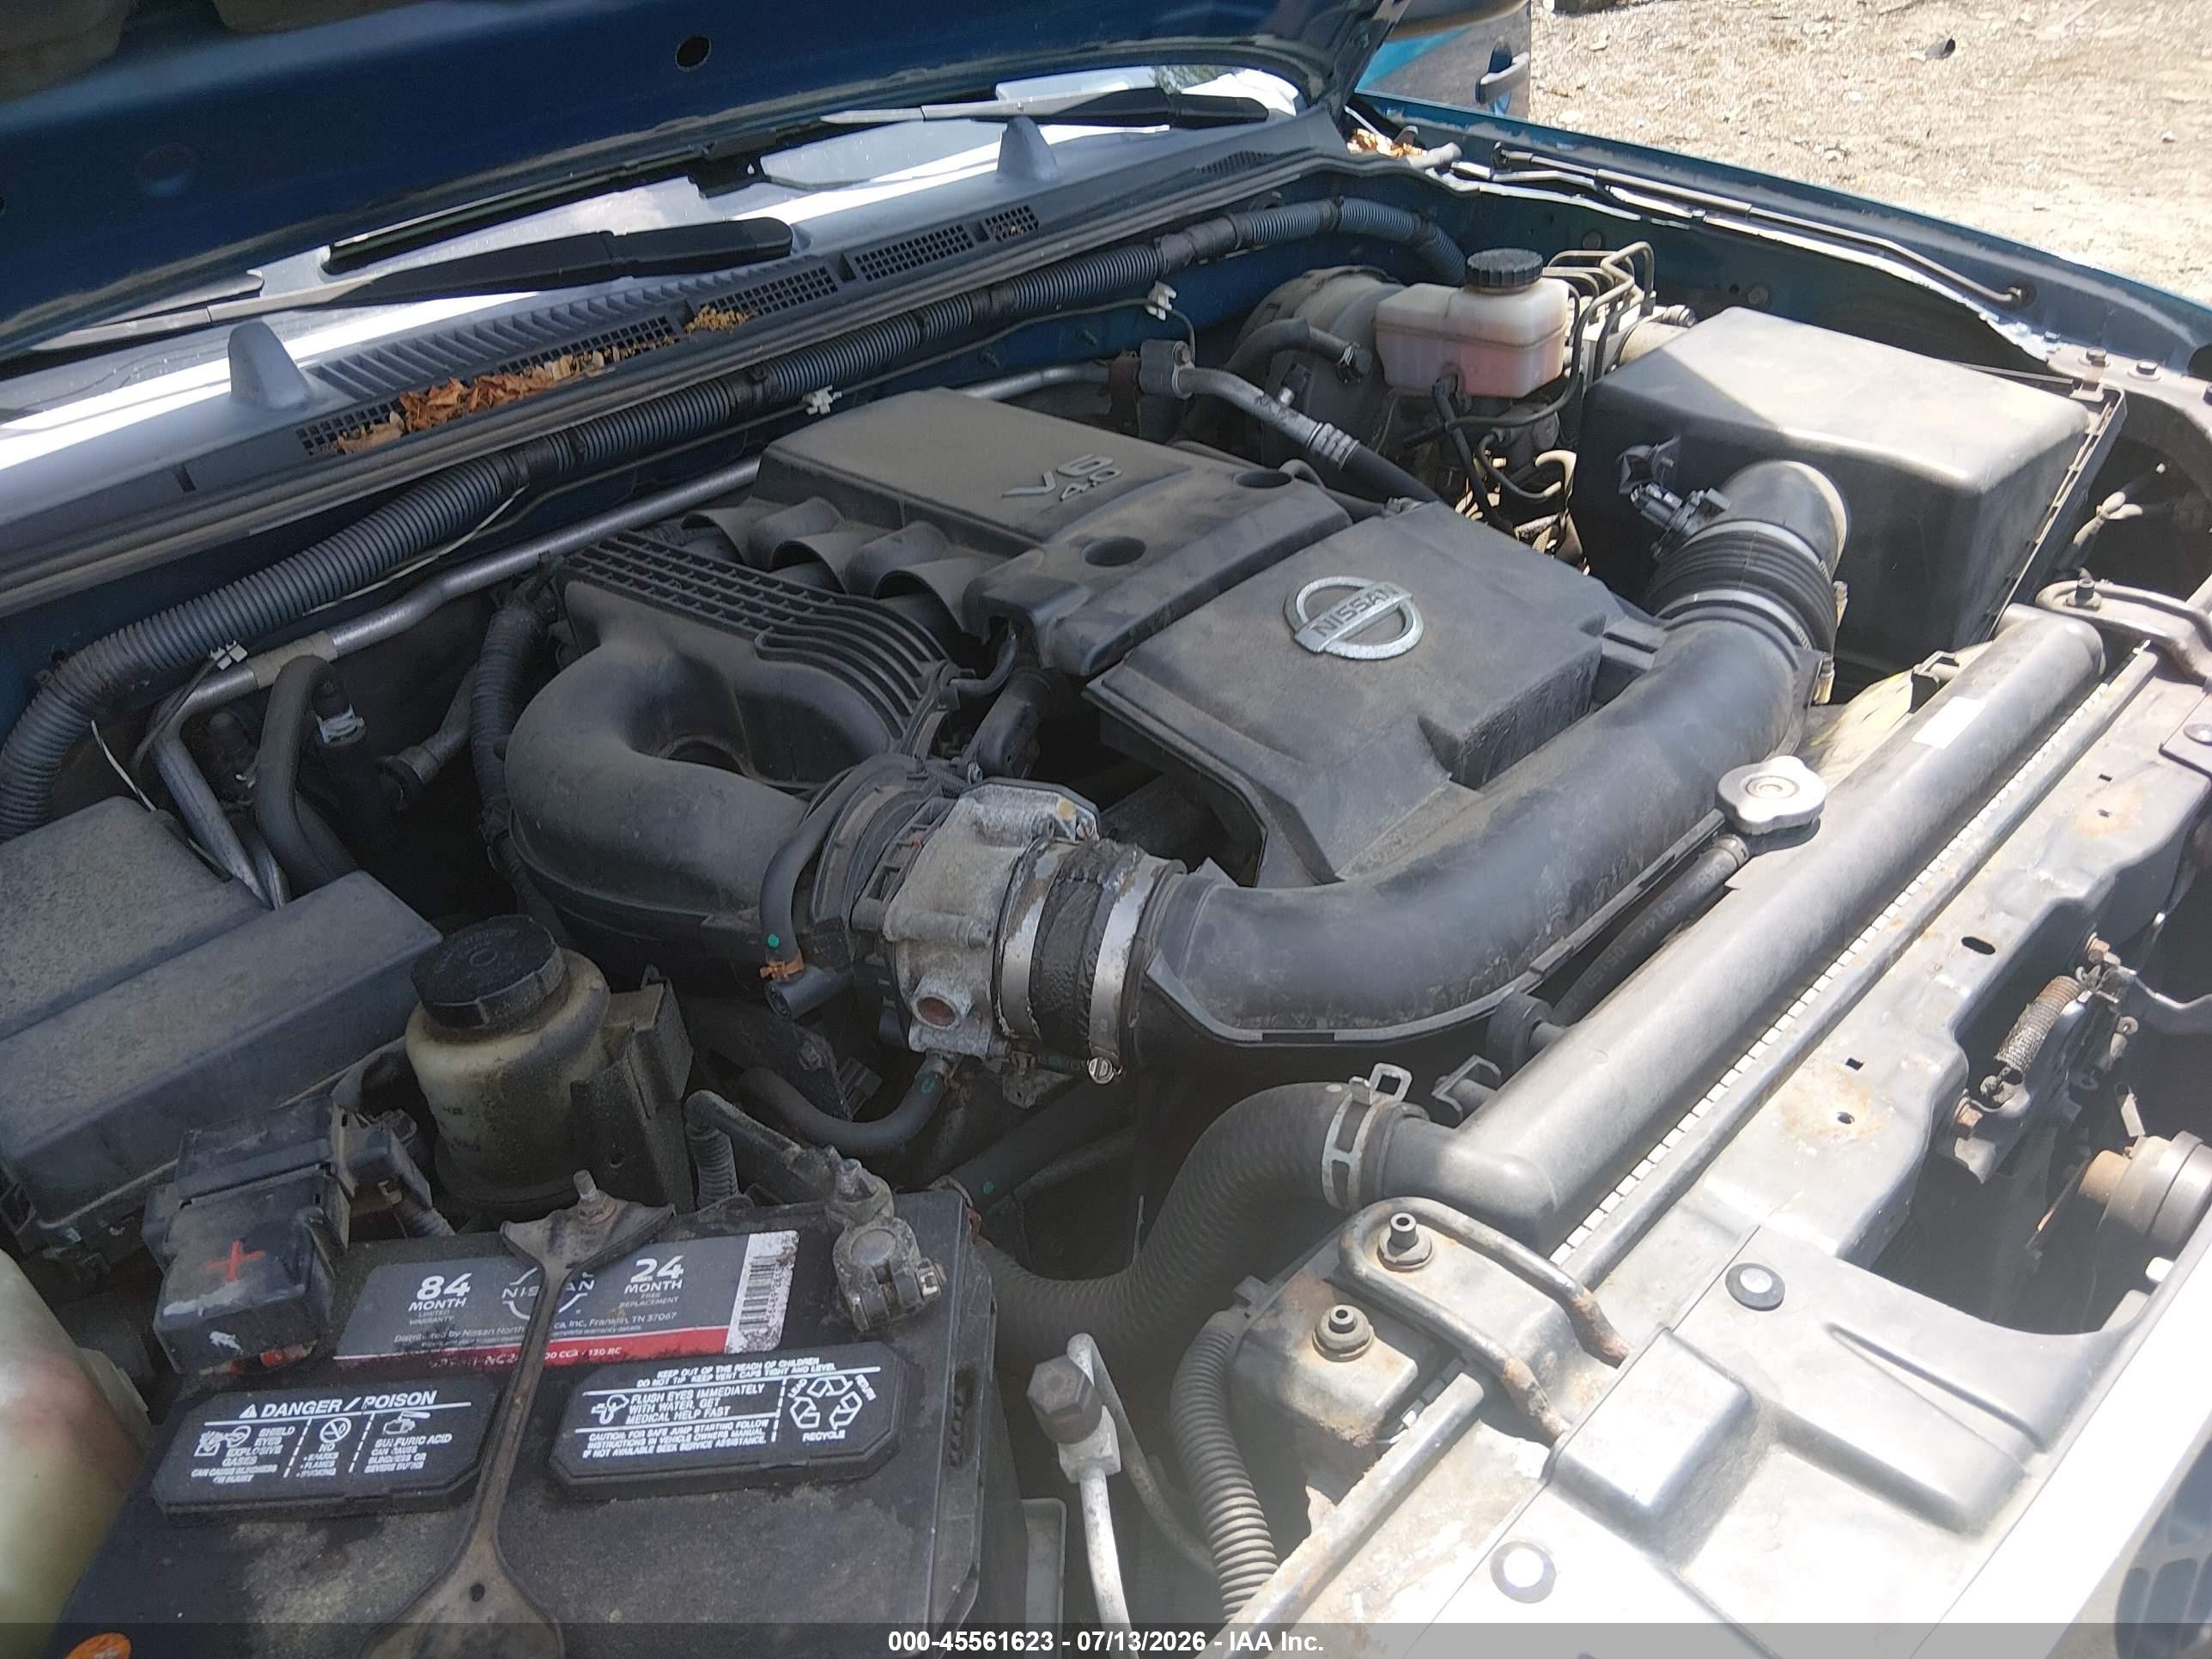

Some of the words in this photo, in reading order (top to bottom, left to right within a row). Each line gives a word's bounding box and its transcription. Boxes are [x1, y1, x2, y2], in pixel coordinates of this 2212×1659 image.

[1001, 453, 1114, 498] V6
[1059, 466, 1122, 501] 4.0
[1310, 582, 1401, 637] NISSAN
[630, 1255, 684, 1283] 24
[416, 1273, 472, 1300] 84
[501, 1279, 595, 1298] NISAN
[624, 1279, 683, 1294] MONTH
[408, 1297, 466, 1312] MONTH
[619, 1296, 679, 1308] REPLACEMENT
[409, 1316, 454, 1326] WARRANTY
[418, 1309, 450, 1318] LIMITED
[632, 1315, 646, 1323] TN
[647, 1312, 678, 1322] 37067
[448, 1330, 462, 1339] by
[462, 1328, 495, 1338] Nissan
[496, 1326, 526, 1336] North
[607, 1346, 623, 1355] RC
[636, 1379, 650, 1388] DO
[652, 1377, 670, 1386] NOT
[690, 1374, 714, 1383] KEEP
[715, 1372, 737, 1381] VENT
[739, 1370, 762, 1378] CAPS
[764, 1366, 788, 1376] TIGHT
[791, 1364, 810, 1374] AND
[657, 1369, 679, 1379] KEEP
[681, 1367, 699, 1377] OUT
[702, 1366, 714, 1375] OF
[715, 1364, 733, 1373] THE
[734, 1361, 763, 1371] REACH
[764, 1360, 776, 1370] OF
[778, 1357, 820, 1368] CHILDREN
[630, 1393, 665, 1404] FLUSH
[667, 1389, 694, 1401] EYES
[696, 1383, 765, 1399] IMMEDIATELY
[260, 1399, 343, 1418] DANGER
[343, 1397, 362, 1411] /
[362, 1390, 438, 1410] POISON
[628, 1404, 655, 1415] WITH
[699, 1397, 720, 1407] GET
[625, 1414, 671, 1425] MEDICAL
[673, 1409, 702, 1421] HELP
[703, 1406, 731, 1418] FAST
[258, 1426, 295, 1437] SHIELD
[628, 1430, 646, 1439] FOR
[647, 1427, 668, 1437] SAFE
[670, 1425, 693, 1436] JUMP
[694, 1421, 733, 1432] STARTING
[735, 1419, 769, 1429] FOLLOW
[802, 1429, 846, 1442] RECYCLE
[254, 1437, 283, 1447] EYES
[427, 1433, 453, 1445] ACID
[587, 1437, 646, 1449] INSTRUCTIONS
[647, 1437, 658, 1445] IN
[659, 1433, 692, 1444] VEHICLE
[226, 1444, 283, 1457] EXPLOSIVE
[319, 1443, 336, 1452] NO
[582, 1449, 590, 1458] IF
[592, 1449, 611, 1458] NOT
[612, 1444, 654, 1456] AVAILABLE
[656, 1443, 678, 1454] SEEK
[679, 1440, 714, 1451] SERVICE
